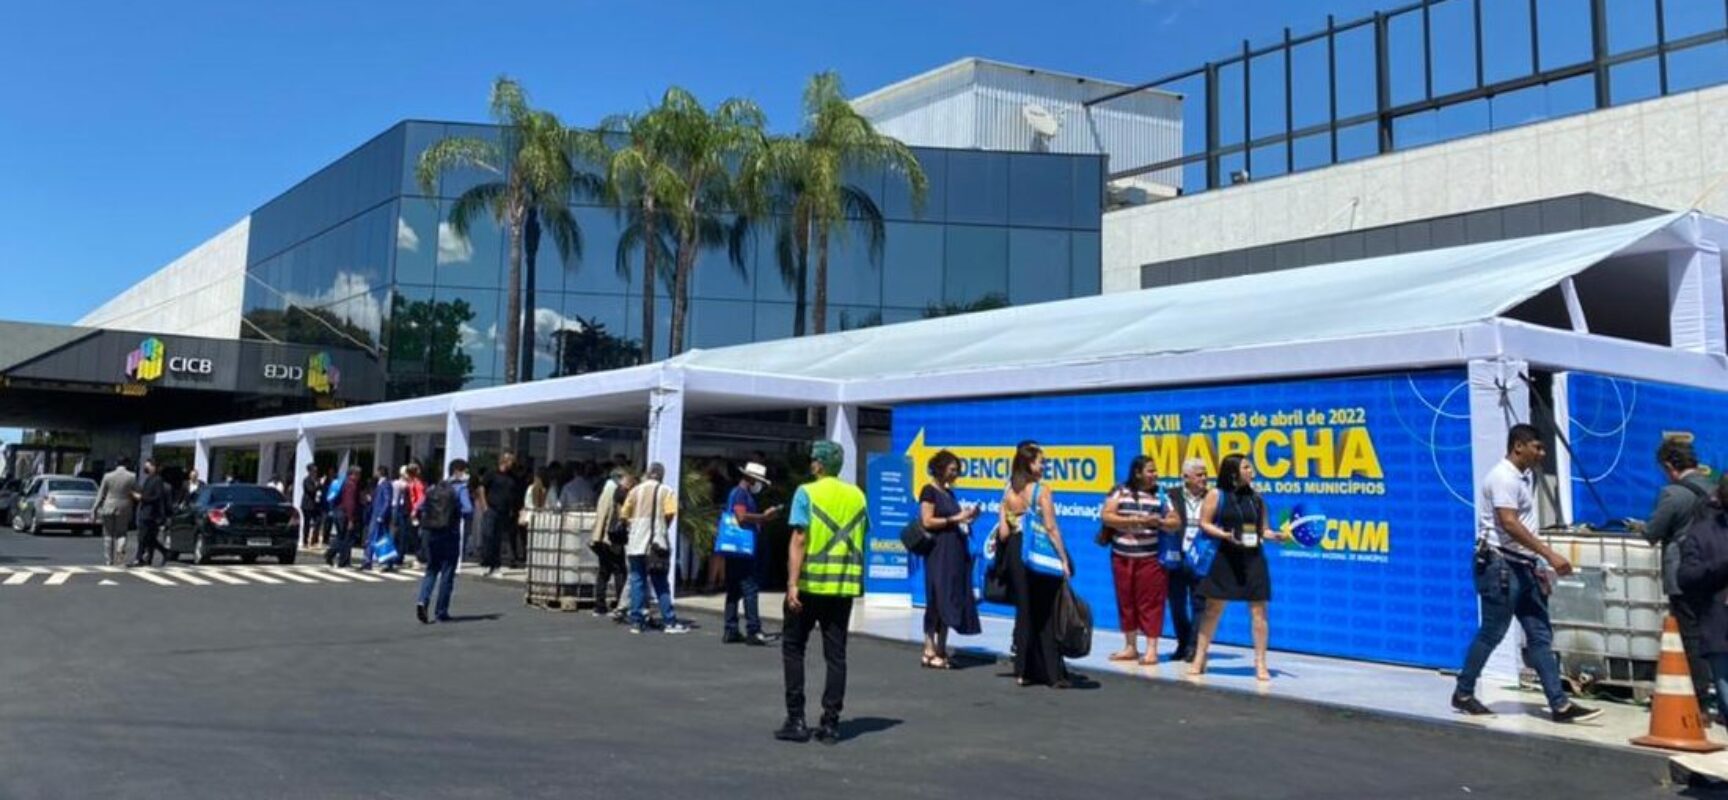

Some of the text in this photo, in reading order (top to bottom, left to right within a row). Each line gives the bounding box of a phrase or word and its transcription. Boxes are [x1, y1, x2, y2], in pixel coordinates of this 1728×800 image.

[169, 356, 212, 374] CICB
[1140, 413, 1181, 432] XXIII
[1200, 406, 1366, 430] 25 a 28 de abril de 2022
[1140, 426, 1385, 480] MARCHA
[1274, 481, 1302, 494] DOS
[1304, 479, 1386, 496] MUNICÍPIOS
[1321, 518, 1389, 553] CNM
